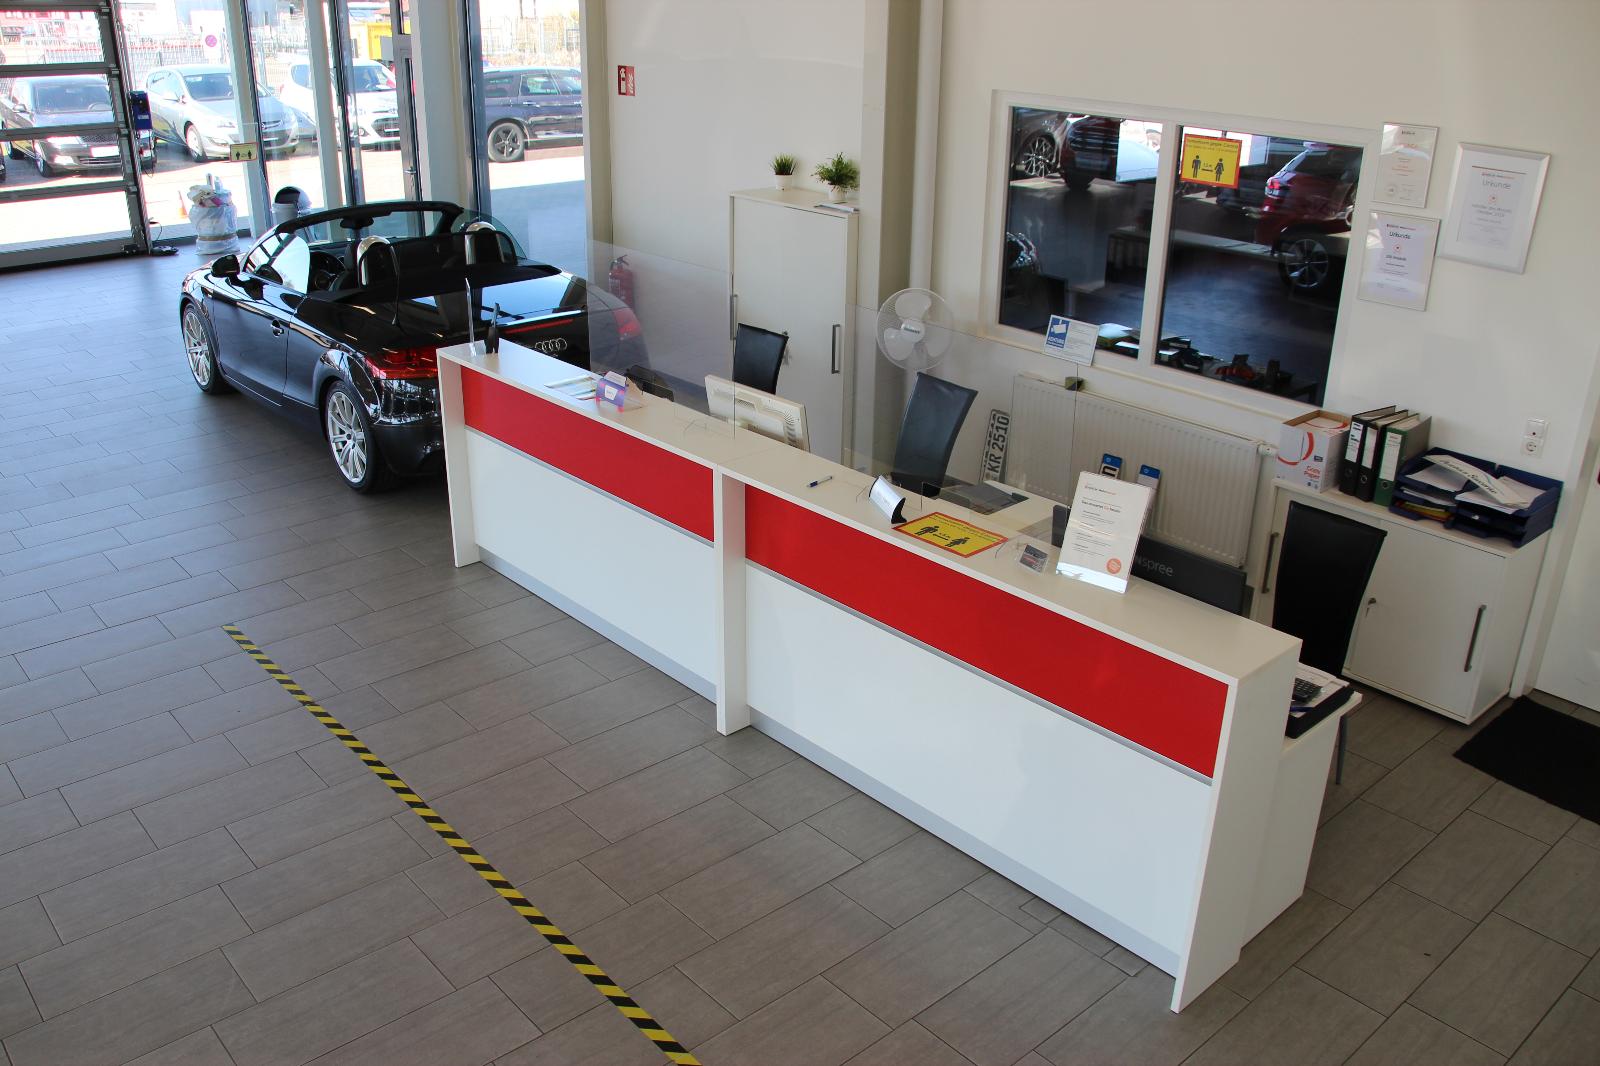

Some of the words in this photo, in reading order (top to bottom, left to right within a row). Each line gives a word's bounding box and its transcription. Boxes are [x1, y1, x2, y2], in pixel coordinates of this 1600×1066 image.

[1482, 179, 1511, 190] Urkunde
[1389, 231, 1411, 239] Urkunde
[991, 415, 1010, 452] 2510
[987, 453, 1002, 473] KR
